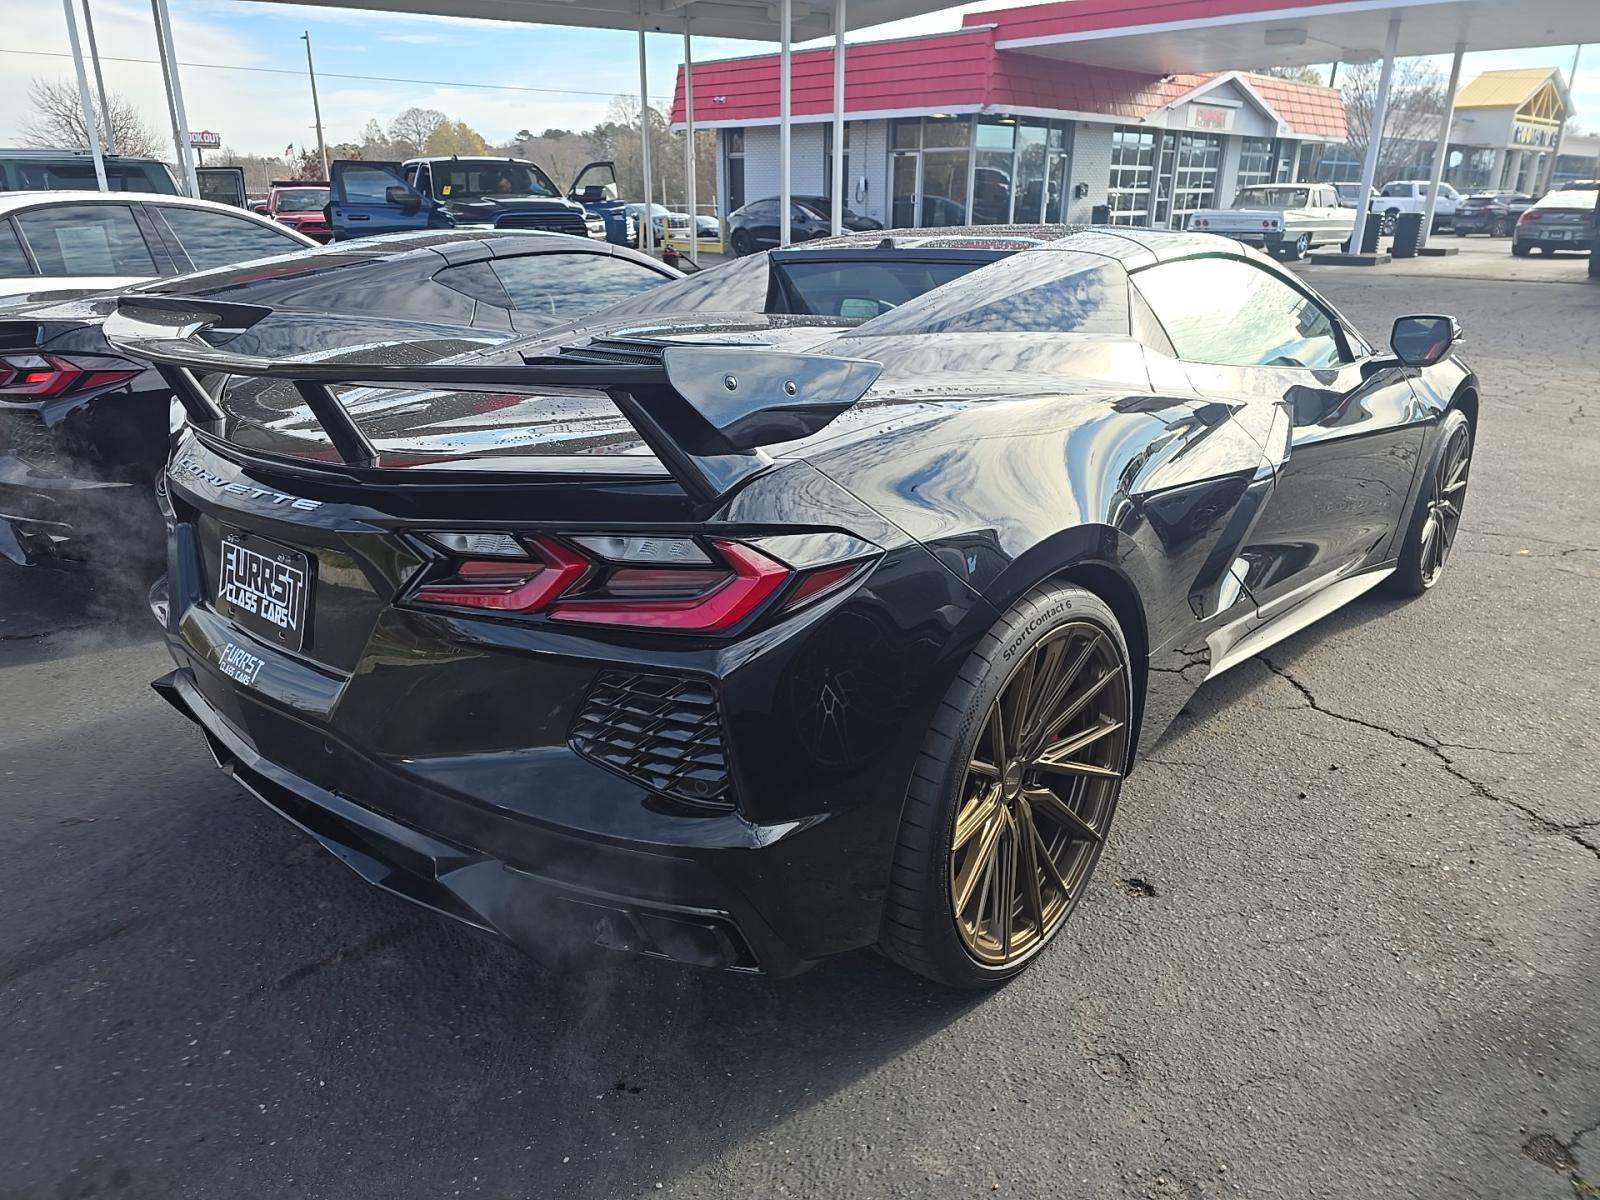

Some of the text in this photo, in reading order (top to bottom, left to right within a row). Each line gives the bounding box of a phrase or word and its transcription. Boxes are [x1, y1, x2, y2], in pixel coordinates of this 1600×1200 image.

[180, 458, 322, 511] CORVETTE
[218, 540, 303, 631] FURRST
[226, 583, 288, 628] CLASS CARS
[1002, 600, 1072, 662] SportContact 6
[218, 642, 265, 684] FURRST
[219, 661, 251, 686] CLASS CARS
